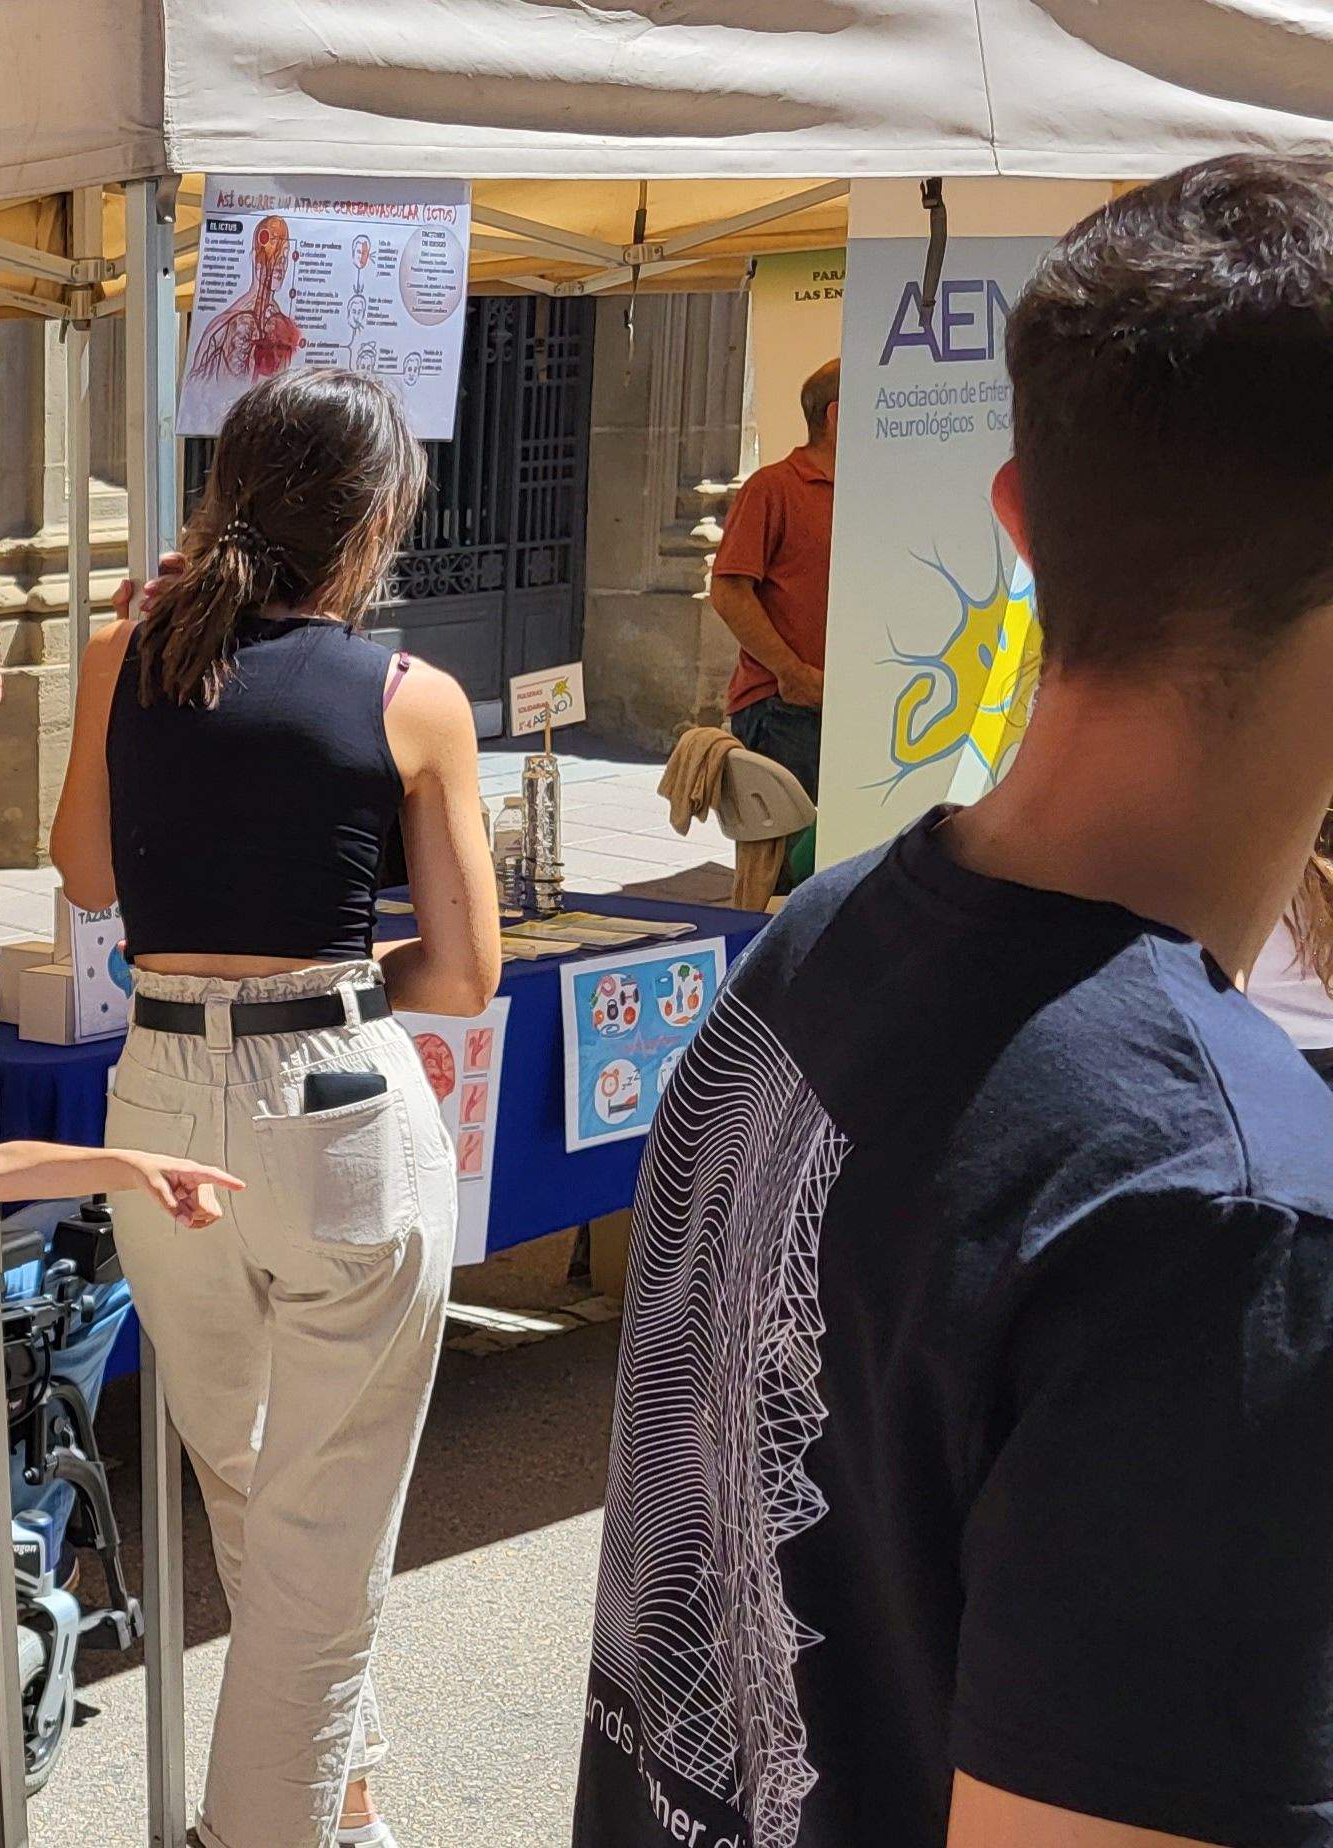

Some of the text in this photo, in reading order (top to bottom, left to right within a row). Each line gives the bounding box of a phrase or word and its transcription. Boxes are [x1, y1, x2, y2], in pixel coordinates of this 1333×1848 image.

[294, 197, 331, 214] ATAQUE
[334, 200, 419, 220] CEREBROVASCULAR
[218, 222, 237, 232] ICTUS
[794, 290, 821, 302] LAS
[875, 382, 958, 410] Asociación
[960, 381, 976, 403] de
[875, 411, 975, 442] Neurológicos
